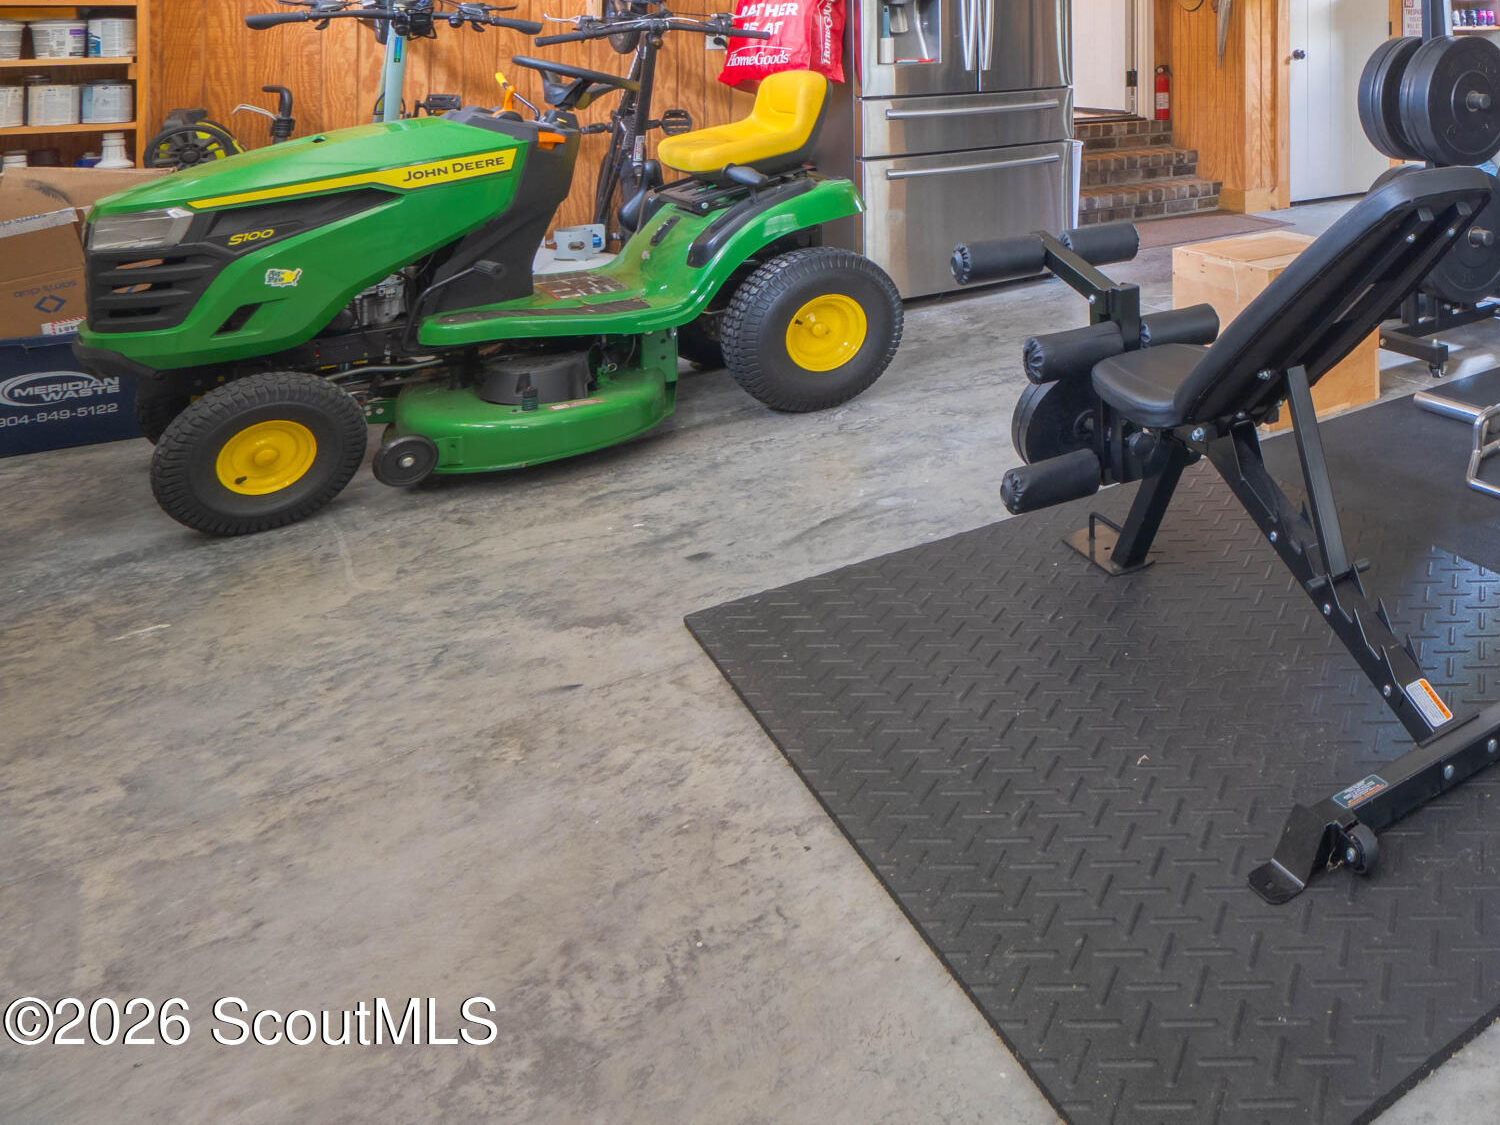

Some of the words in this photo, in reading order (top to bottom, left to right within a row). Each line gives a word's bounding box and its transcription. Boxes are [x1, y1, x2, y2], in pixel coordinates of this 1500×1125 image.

[726, 50, 789, 67] HomeGoods
[403, 166, 448, 182] JOHN
[452, 157, 505, 173] DEERE
[228, 229, 274, 245] S100
[13, 376, 120, 397] MERIDIAN
[41, 385, 120, 402] WASTE
